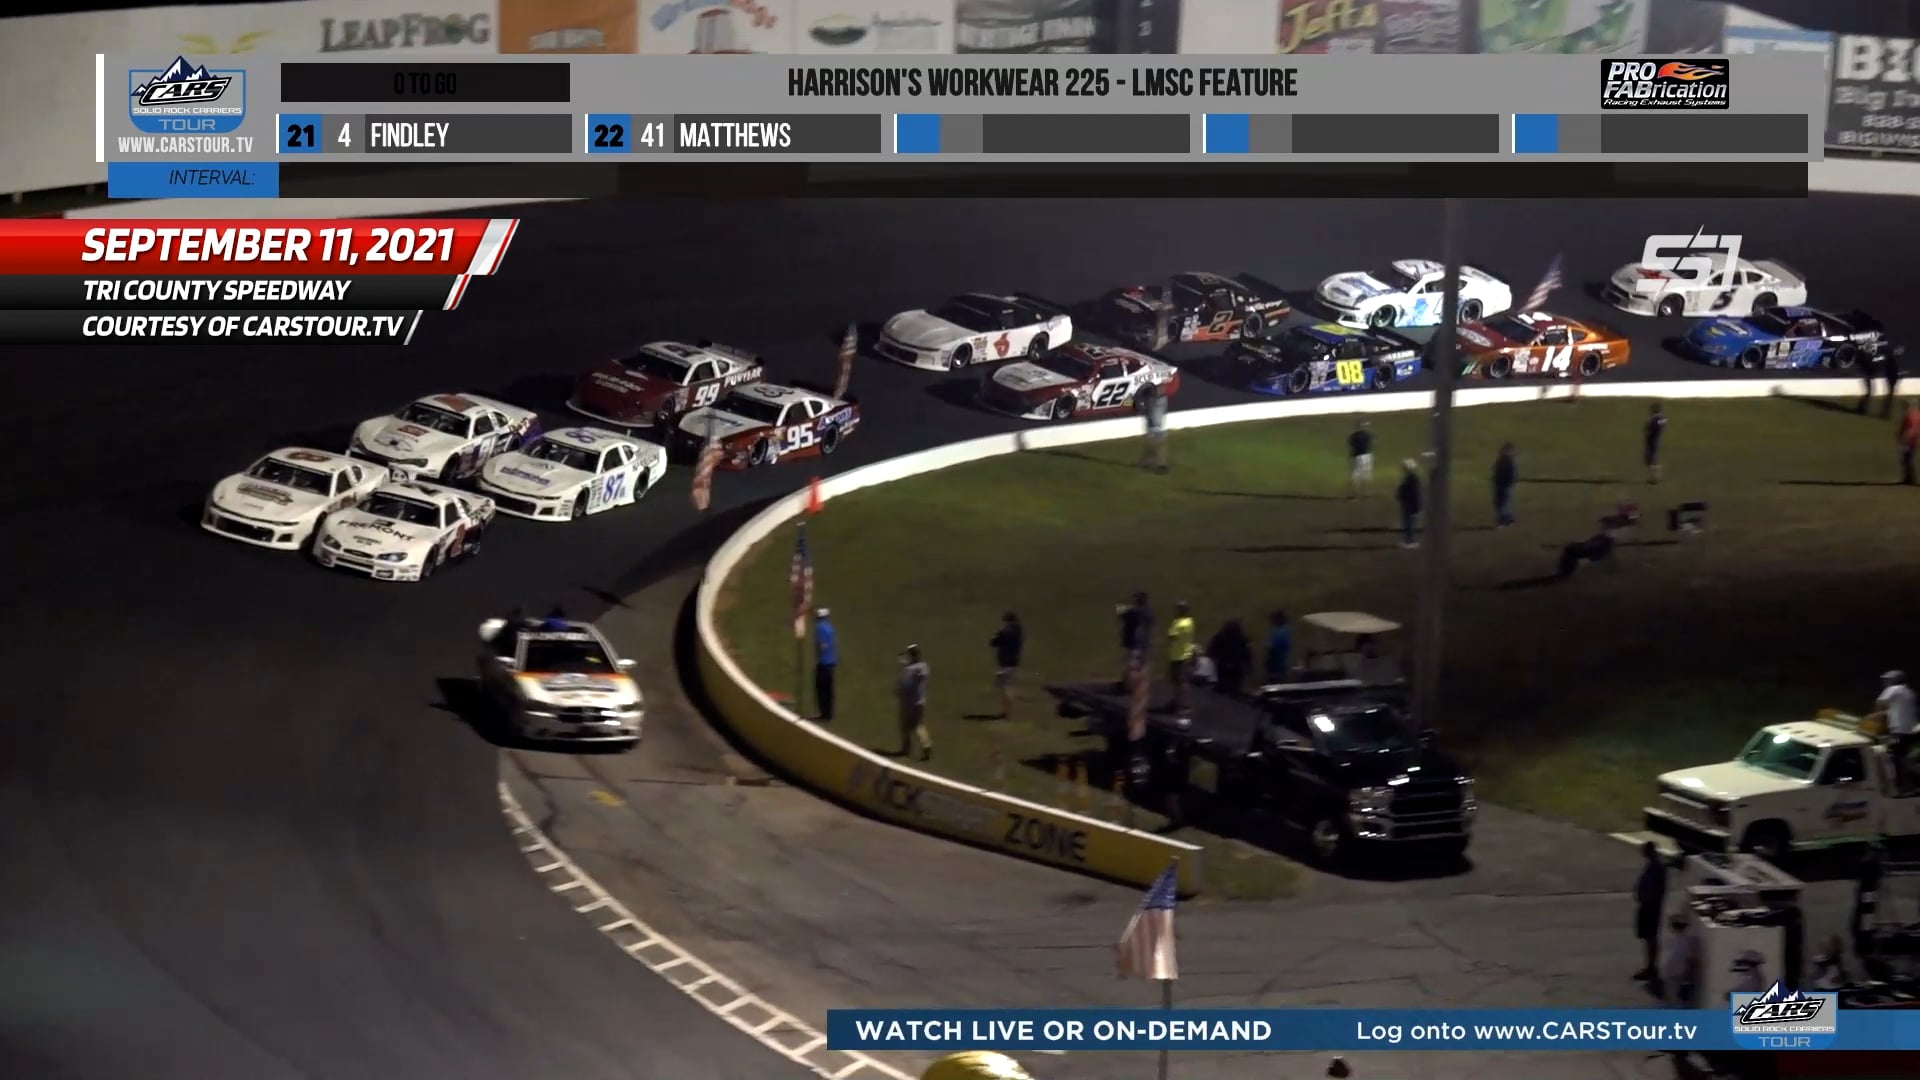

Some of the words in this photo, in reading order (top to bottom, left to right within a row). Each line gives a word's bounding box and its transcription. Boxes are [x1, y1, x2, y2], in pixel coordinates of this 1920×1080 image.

[1835, 34, 1920, 82] BI
[1336, 359, 1364, 385] 08
[1541, 345, 1574, 373] 14
[692, 382, 721, 408] 99
[1096, 382, 1130, 408] 22
[787, 422, 815, 451] 95
[602, 472, 626, 503] 87
[338, 519, 416, 542] FREMONT
[1004, 812, 1087, 863] ZONE
